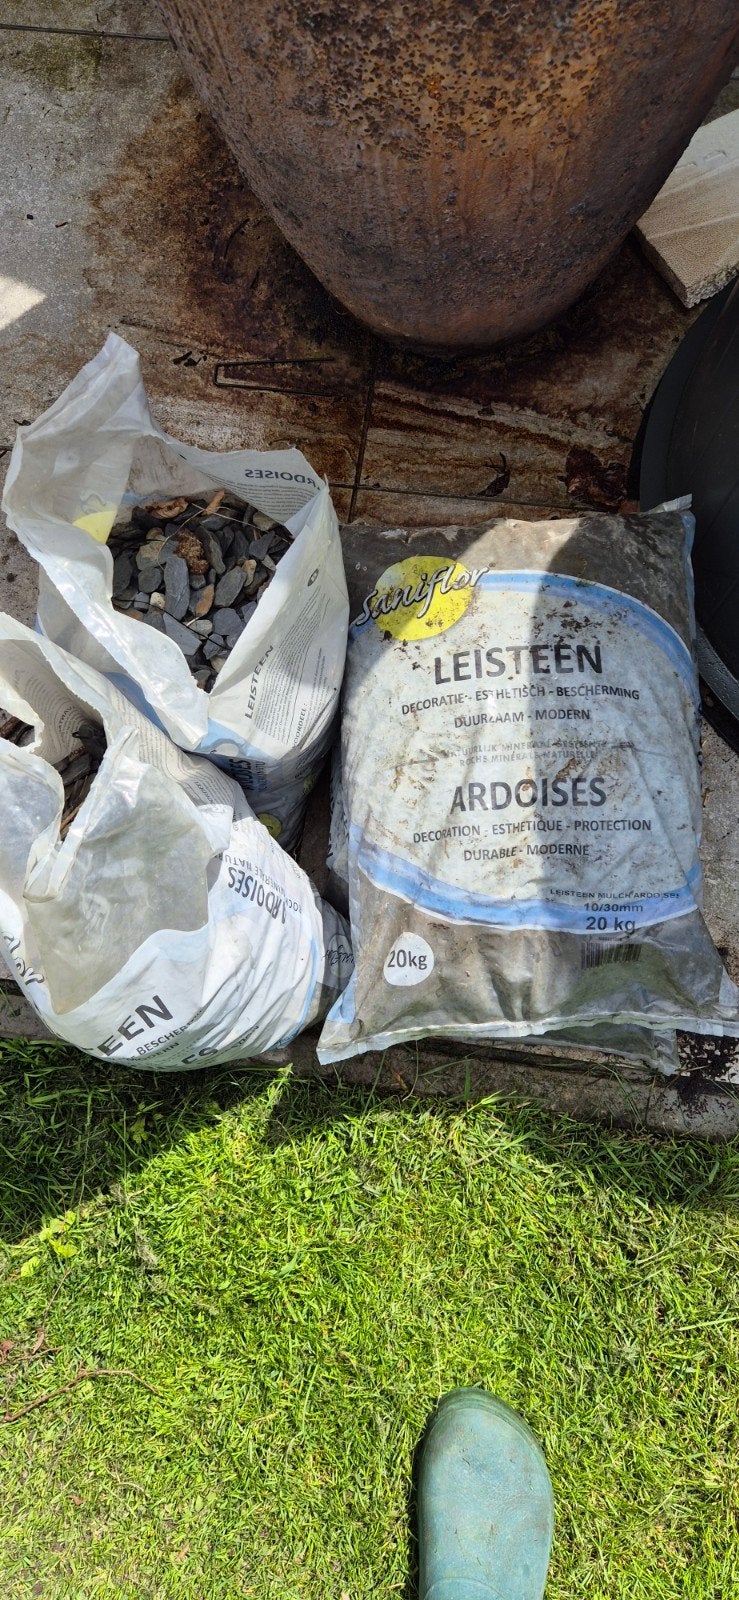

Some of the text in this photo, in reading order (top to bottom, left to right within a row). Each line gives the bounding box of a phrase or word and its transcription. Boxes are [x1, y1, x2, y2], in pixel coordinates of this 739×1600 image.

[350, 564, 489, 626] Saniflor
[434, 644, 603, 685] LEISTEEN
[244, 645, 274, 719] LEISTEEN
[401, 693, 464, 715] DECORATIE
[556, 684, 640, 701] BESCHERMING
[535, 709, 590, 722] MODERN
[450, 777, 607, 812] ARDOISES
[413, 825, 481, 844] DECORATION
[492, 820, 562, 835] ESTHETIQUE
[574, 819, 651, 832] PROTECTION
[463, 846, 517, 862] DURABLE
[526, 843, 589, 857] MODERNE
[550, 888, 595, 898] LEISTEEN
[584, 902, 644, 912] 10/30mm
[586, 916, 636, 935] 20 kg
[387, 949, 428, 970] 20kg
